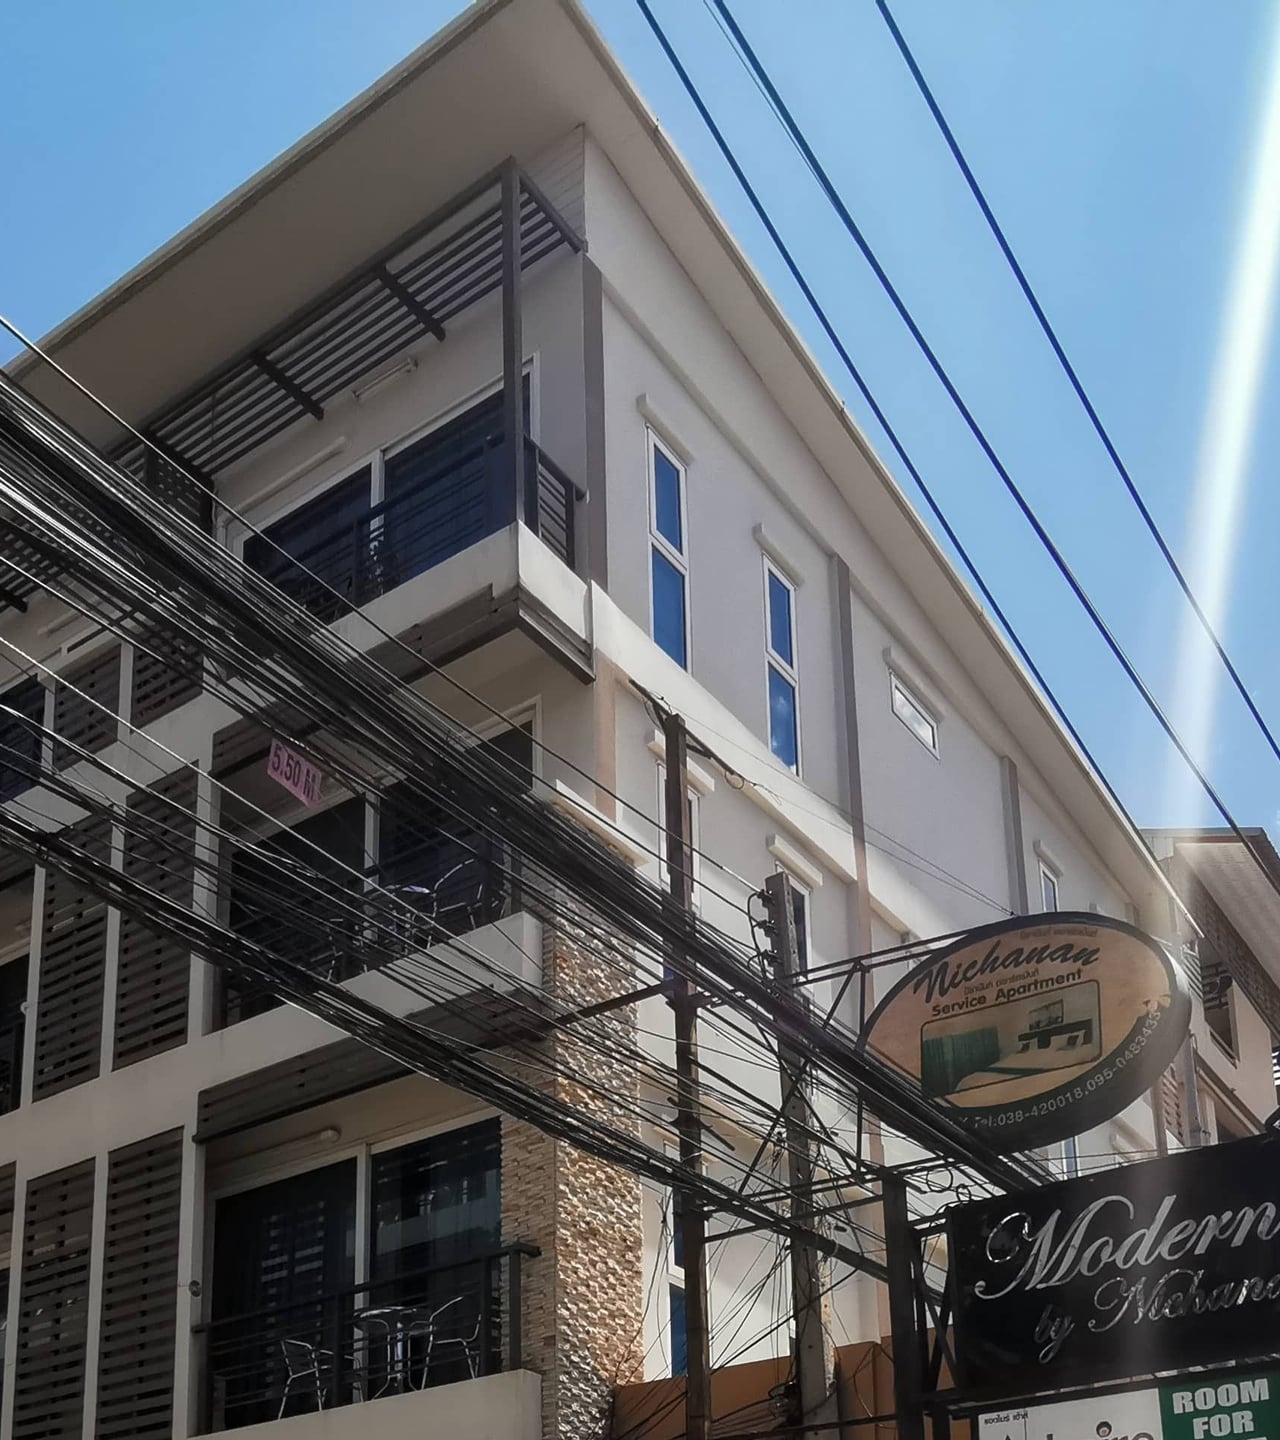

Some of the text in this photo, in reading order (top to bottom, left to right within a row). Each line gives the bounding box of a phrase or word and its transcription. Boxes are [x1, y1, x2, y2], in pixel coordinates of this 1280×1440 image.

[913, 940, 1101, 1003] Nichanan
[931, 968, 1083, 1018] Service Apartment
[1035, 1304, 1074, 1365] by
[1172, 1378, 1269, 1414] ROOM
[1192, 1410, 1254, 1440] FOR
